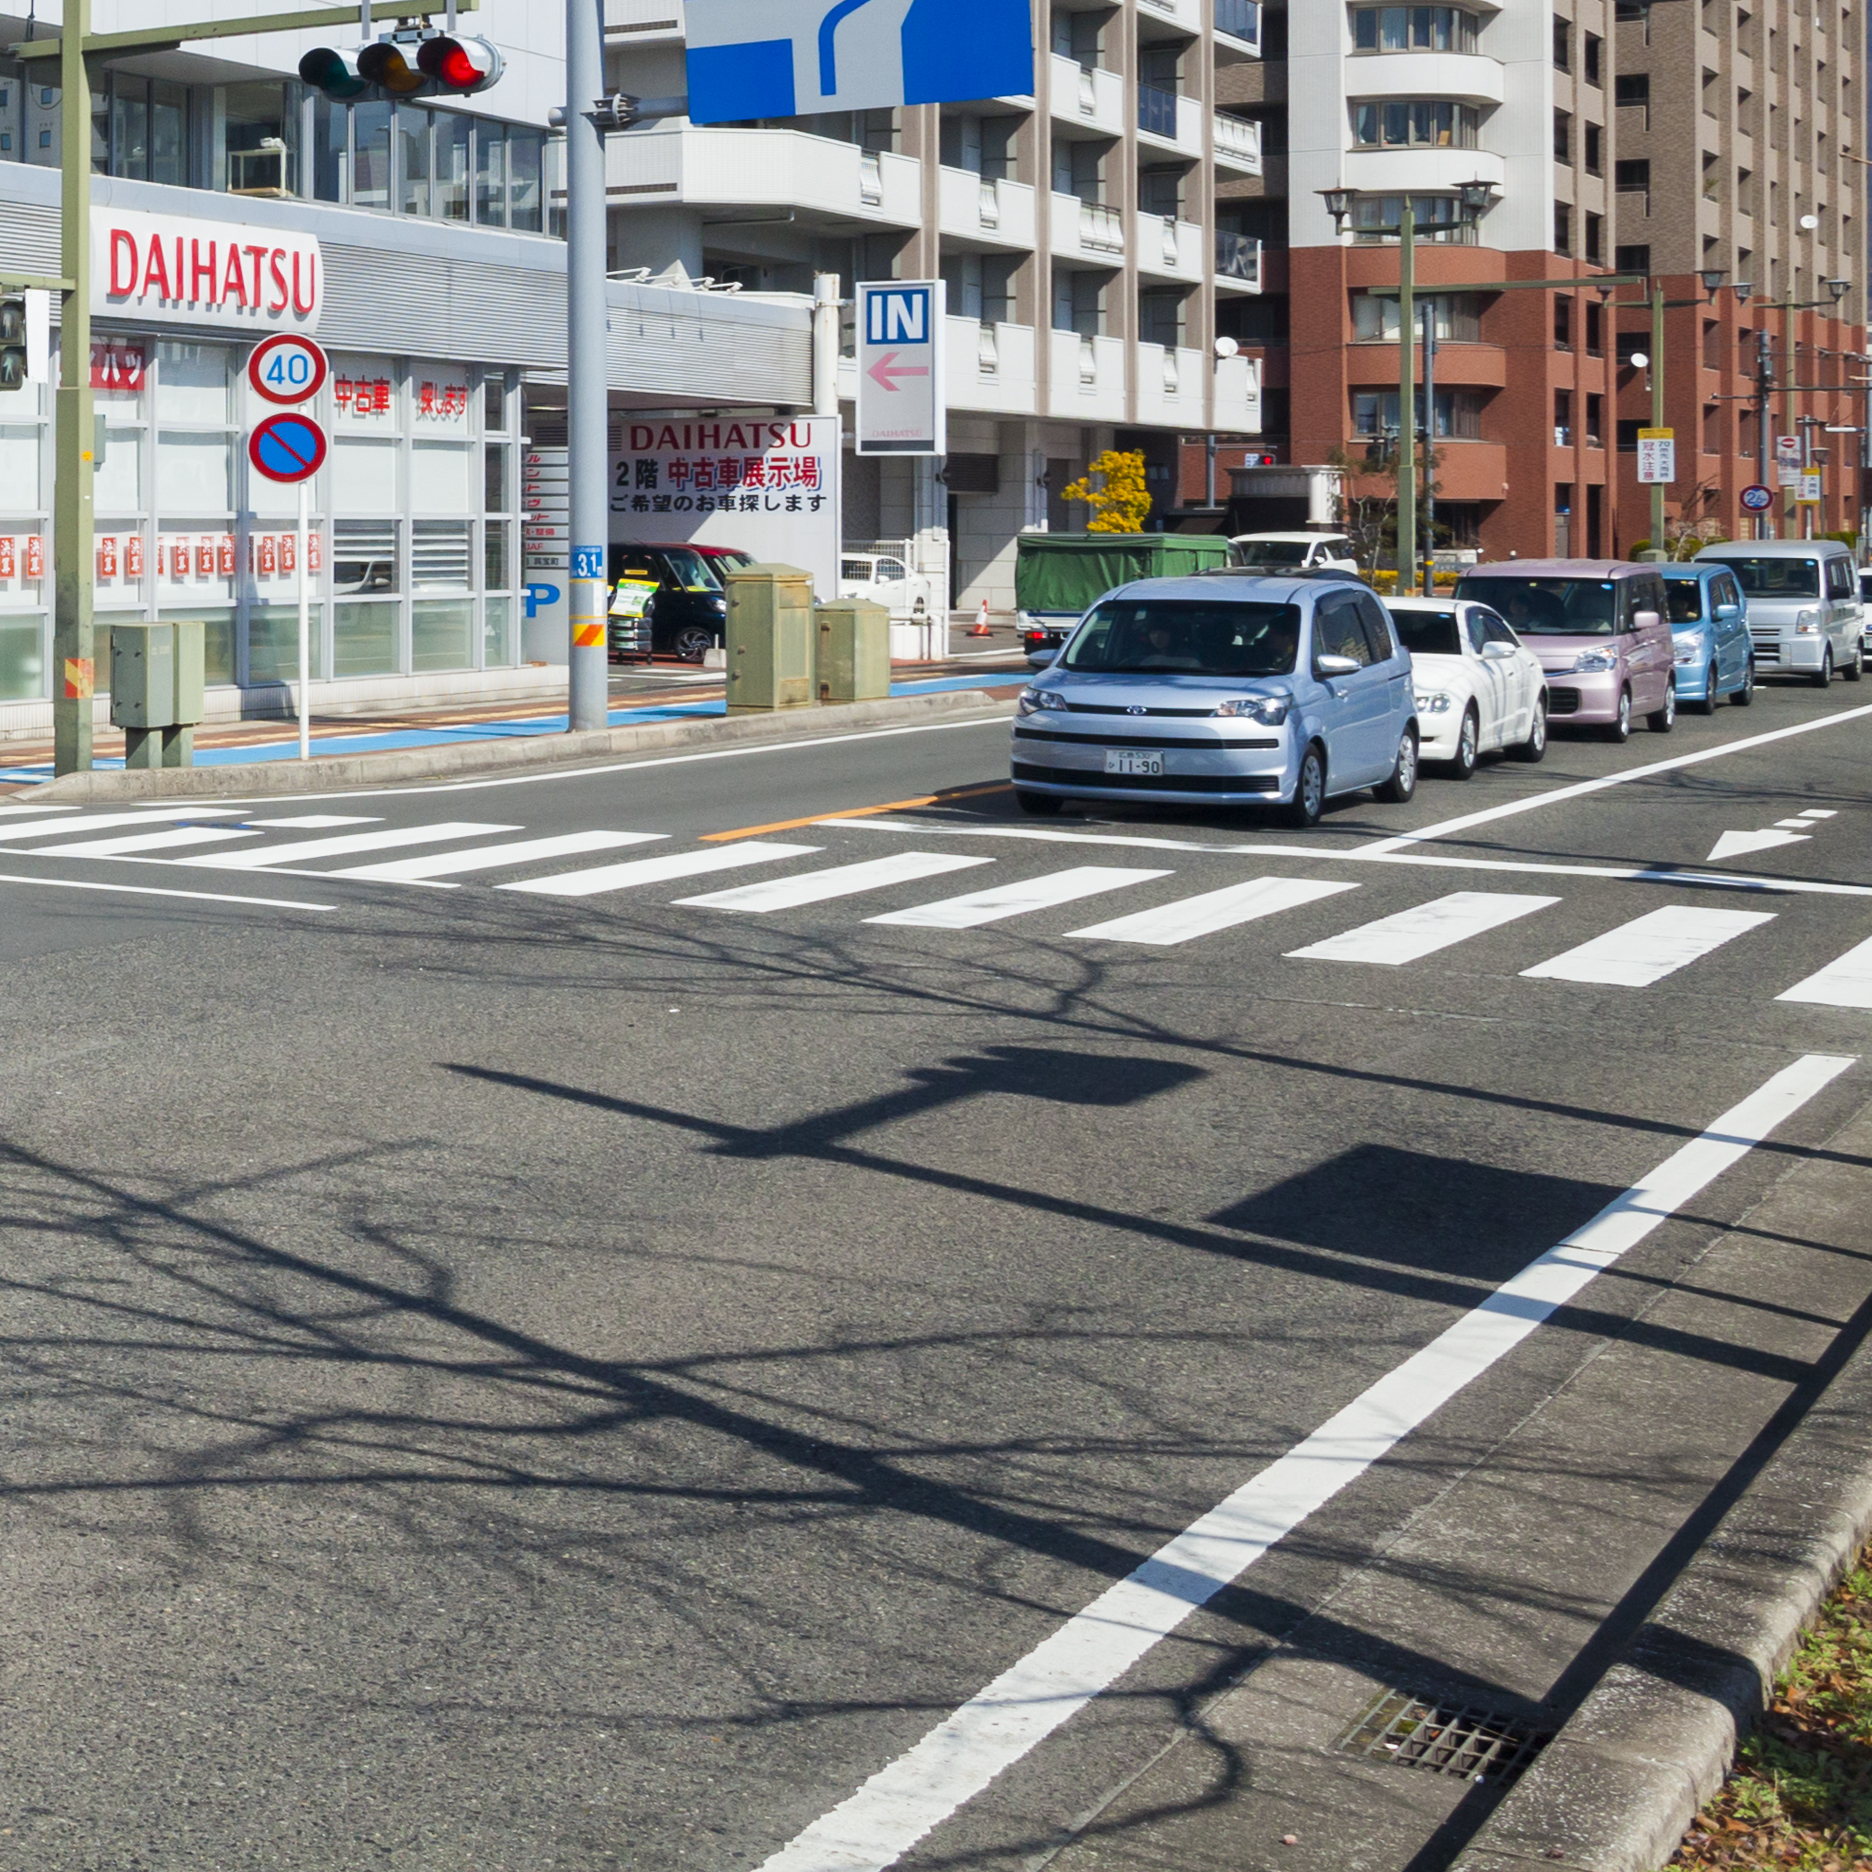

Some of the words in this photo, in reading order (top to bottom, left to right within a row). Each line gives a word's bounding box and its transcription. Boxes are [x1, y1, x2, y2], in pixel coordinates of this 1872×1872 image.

[110, 229, 314, 314] DAIHATSU
[871, 294, 923, 340] IN
[267, 353, 308, 385] 40
[335, 374, 390, 414] 中古車
[420, 381, 468, 416] 探します
[630, 422, 812, 451] DAIHATSU
[872, 430, 922, 438] DAIHATSU
[668, 456, 819, 489] 中古車展示場
[610, 494, 827, 513] ご希望のお車探します
[526, 583, 560, 617] P
[1119, 759, 1160, 774] 11-90
